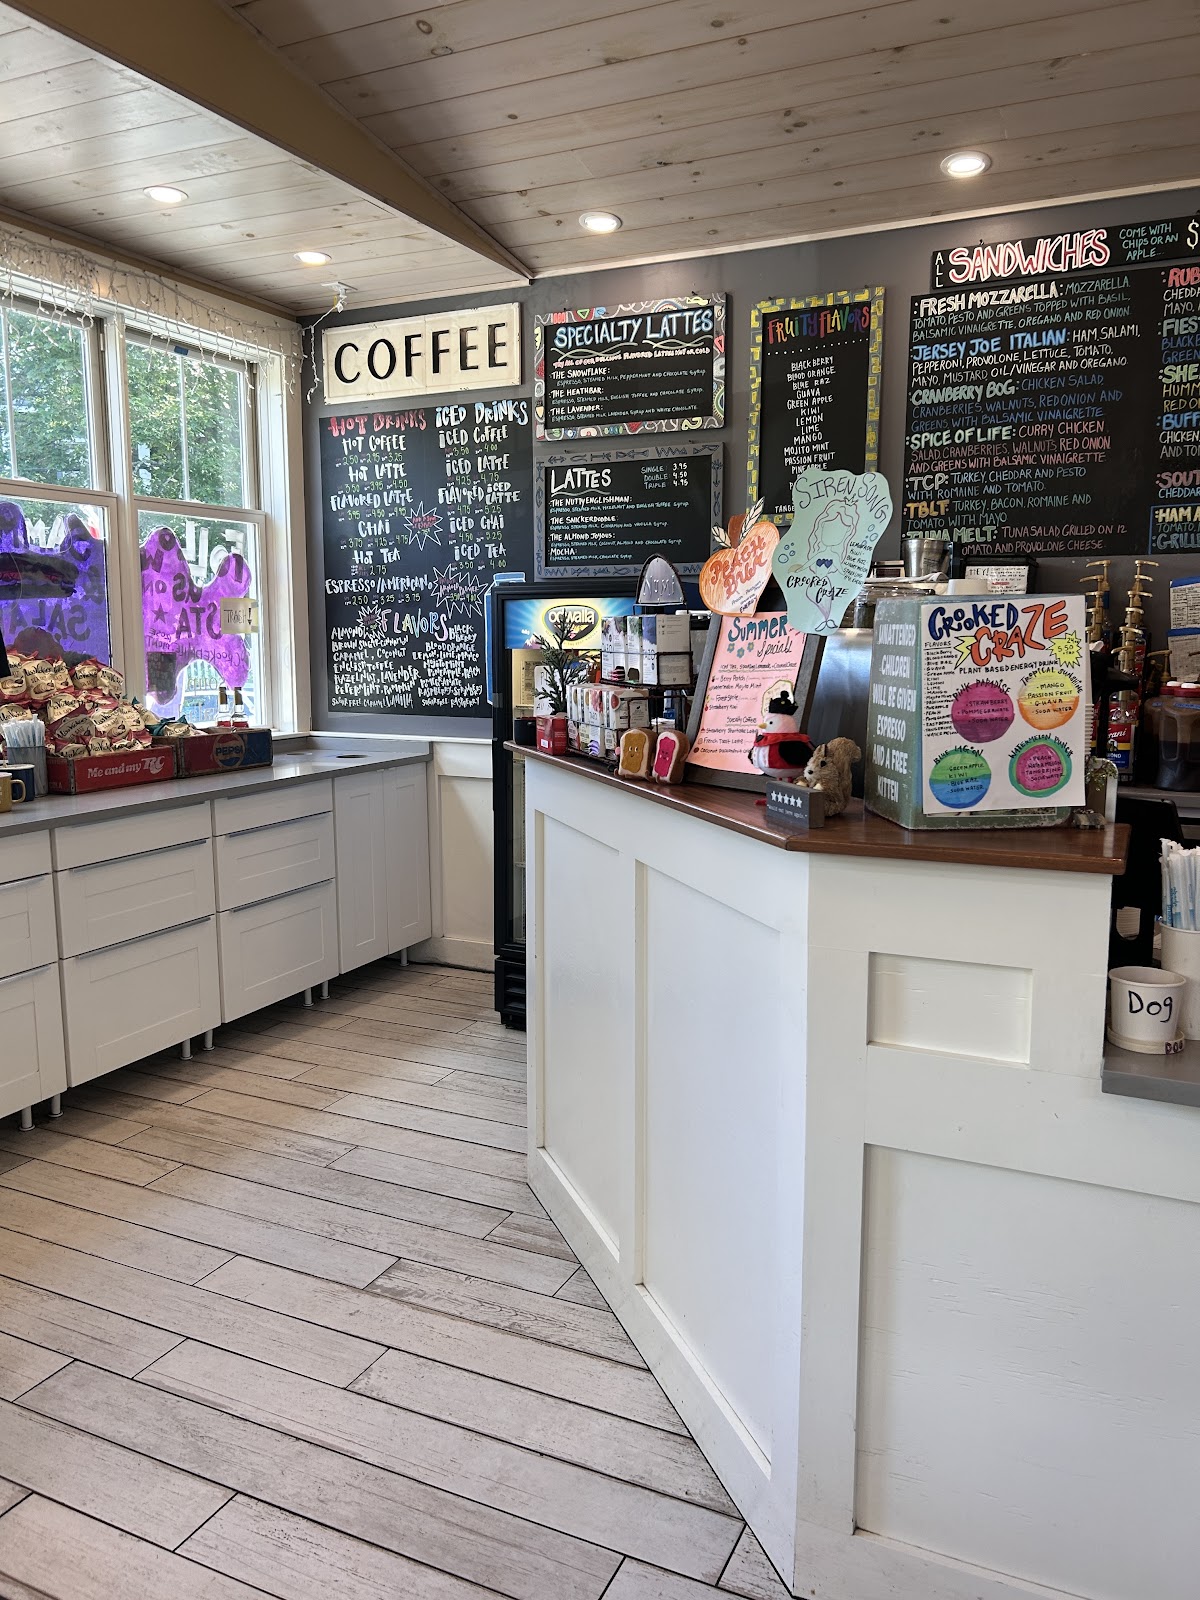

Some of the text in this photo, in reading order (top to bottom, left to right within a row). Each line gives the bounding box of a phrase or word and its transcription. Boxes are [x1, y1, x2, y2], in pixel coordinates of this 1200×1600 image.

[1120, 222, 1172, 240] COME WITH
[1187, 219, 1199, 250] $
[1122, 234, 1179, 250] CHIPS OR AN
[948, 228, 1110, 284] SANDWICHES
[934, 252, 944, 288] ALL
[920, 296, 966, 318] FRESH
[948, 296, 1095, 327] PESTO GREENS TOPPED WITH
[554, 308, 714, 350] SPECIALTY LATTES
[818, 306, 870, 338] FLAVORS
[912, 315, 1062, 342] BALSAMIC OREGANO
[334, 322, 507, 384] COFFEE
[912, 340, 966, 362] JERSEY
[969, 337, 1001, 354] JOE
[552, 369, 566, 380] THE
[787, 366, 836, 382] BLOOD ORANGE
[990, 362, 1057, 378] OIL/VINEGAR
[792, 378, 831, 390] BLUE RAZ
[910, 386, 983, 406] CRANBERRY
[1022, 376, 1066, 391] CHICKEN
[551, 388, 565, 398] THE
[796, 388, 820, 399] GUAVA
[787, 394, 834, 410] GREEN APPLE
[1164, 400, 1187, 413] RED
[550, 406, 565, 416] THE
[800, 406, 820, 416] KIWI
[982, 406, 1104, 426] BALSAMIC VINAIGRETTE
[328, 416, 368, 437] HOT
[796, 412, 824, 427] LEMON
[473, 425, 508, 444] COFFEE
[802, 424, 820, 435] LIME
[910, 430, 952, 450] SPICE
[954, 427, 976, 444] OF
[1018, 424, 1054, 438] CURRY
[1058, 420, 1105, 436] CHICKEN
[342, 434, 406, 456] HOT COFFEE
[794, 432, 822, 446] MANGO
[1060, 438, 1080, 452] RED
[784, 442, 830, 456] MOJITO MINT
[478, 454, 510, 472] LATTE
[784, 452, 836, 466] PASSION FRUIT
[375, 463, 407, 480] LATTE
[989, 468, 1032, 483] CHEDDAR
[1056, 466, 1086, 478] PESTO
[551, 467, 612, 494] LATTES
[330, 488, 414, 512] FLAVORED LATTE
[438, 485, 484, 504] FLAVORED
[552, 498, 564, 507] THE
[795, 472, 889, 523] SIREN SONG
[1028, 495, 1069, 508] ROMAINE
[550, 516, 564, 525] THE
[1158, 506, 1192, 522] HAM
[906, 518, 945, 530] TOMATO
[1001, 526, 1030, 538] TUNA
[1062, 524, 1095, 536] GRILLED
[1098, 524, 1114, 534] ON
[1117, 524, 1128, 534] 12
[550, 532, 590, 542] THE ALMOND
[352, 548, 400, 564] HOT TEA
[485, 543, 506, 558] TEA
[962, 540, 1064, 556] OMATO PROVOLONE
[786, 576, 828, 588] CROOKED
[816, 587, 850, 604] CRAZE
[548, 608, 595, 624] odwalla
[928, 602, 1018, 641] CROOKED
[382, 608, 448, 642] FLAVORS
[971, 600, 1068, 667] CRAZE
[924, 640, 951, 648] FLAVORS
[376, 648, 406, 658] COCONUT
[880, 654, 911, 678] CHILDREN
[984, 664, 1009, 673] BASED
[1009, 662, 1038, 672] ENERGY
[1040, 682, 1064, 690] MANGO
[872, 684, 916, 712] WILL BE GIVEN
[1028, 691, 1053, 699] PASSION
[876, 714, 906, 742] ESPRESSO
[216, 744, 244, 756] PEPSI
[872, 743, 908, 774] AND A FREE
[88, 756, 165, 778] Me and my RC
[877, 774, 899, 802] KITTEN
[1128, 990, 1172, 1022] Dog
